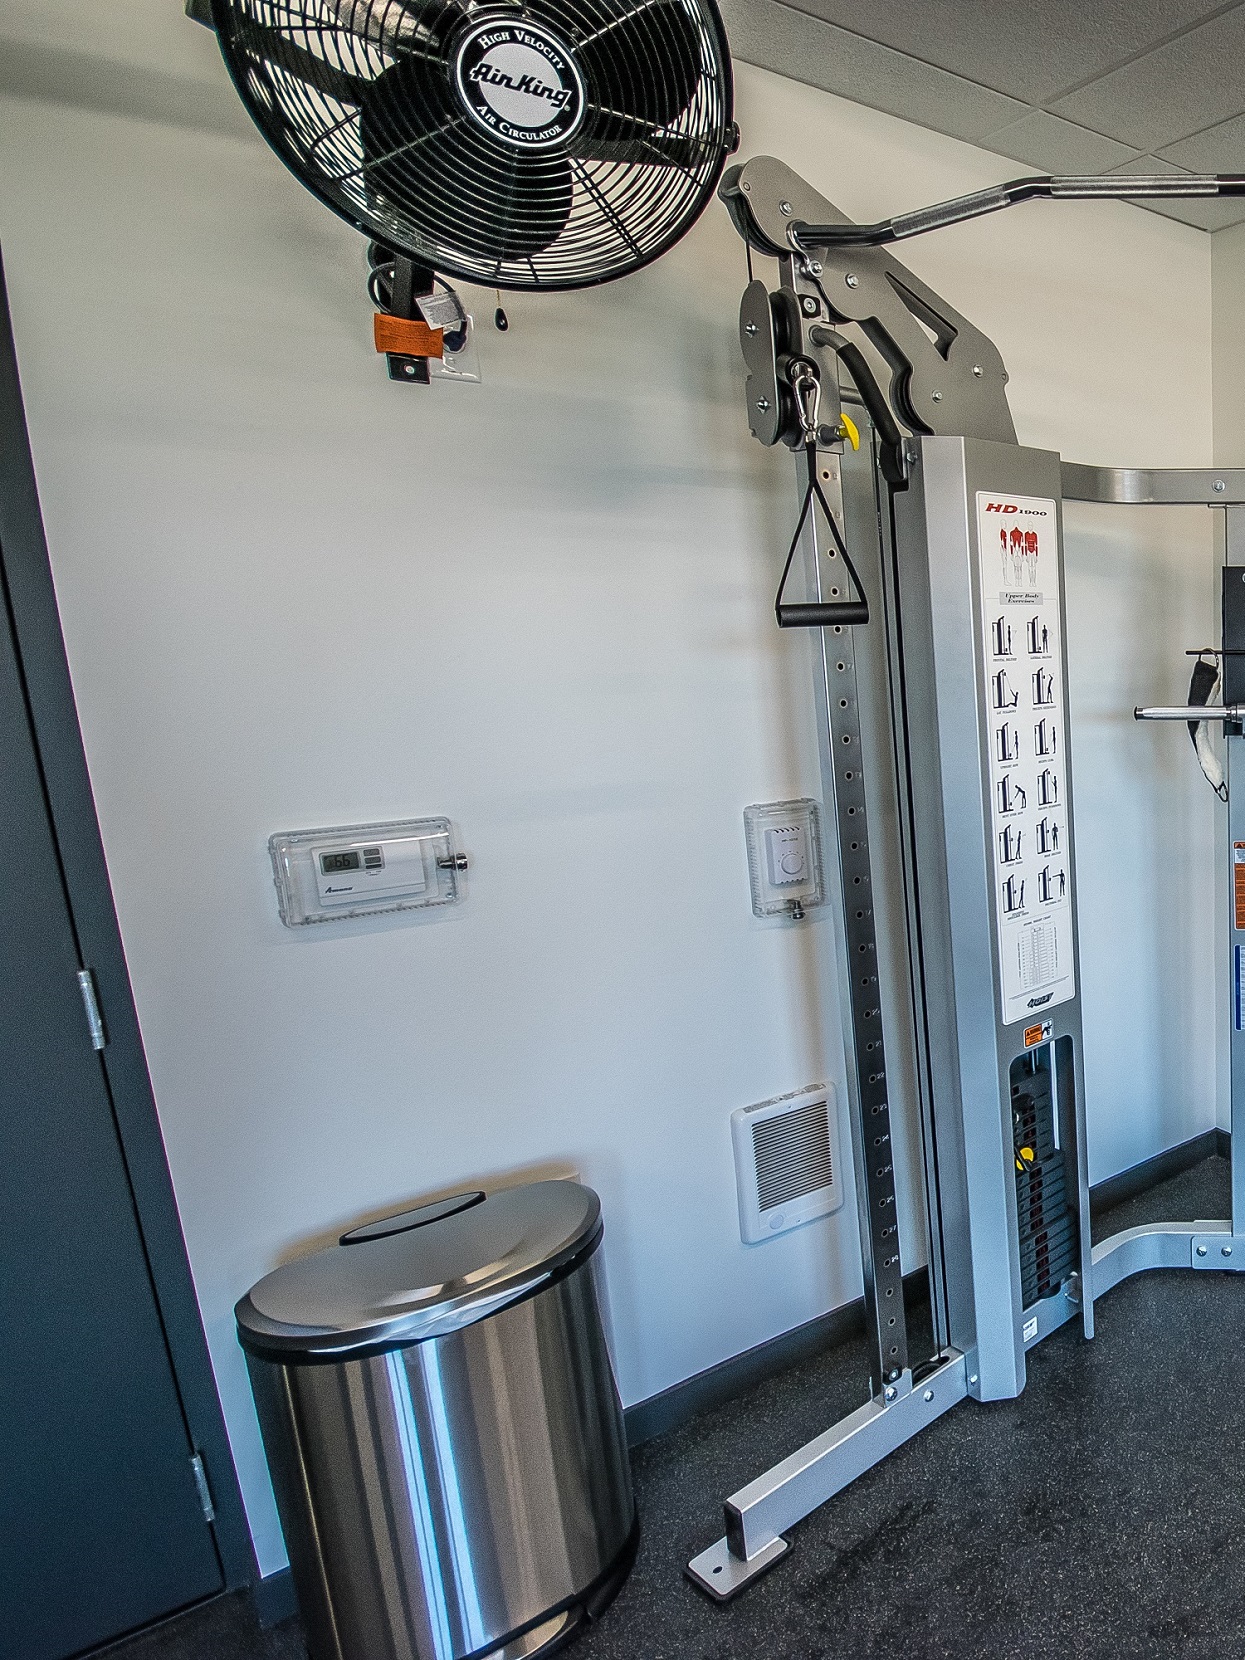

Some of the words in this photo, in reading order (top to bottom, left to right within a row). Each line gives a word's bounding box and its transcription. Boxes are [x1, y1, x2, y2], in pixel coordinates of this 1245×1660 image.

[477, 32, 511, 49] HIGH
[514, 30, 565, 70] VELOCITY
[477, 104, 497, 126] AIR
[499, 124, 563, 141] CIRCULATOR
[985, 503, 1018, 513] HD
